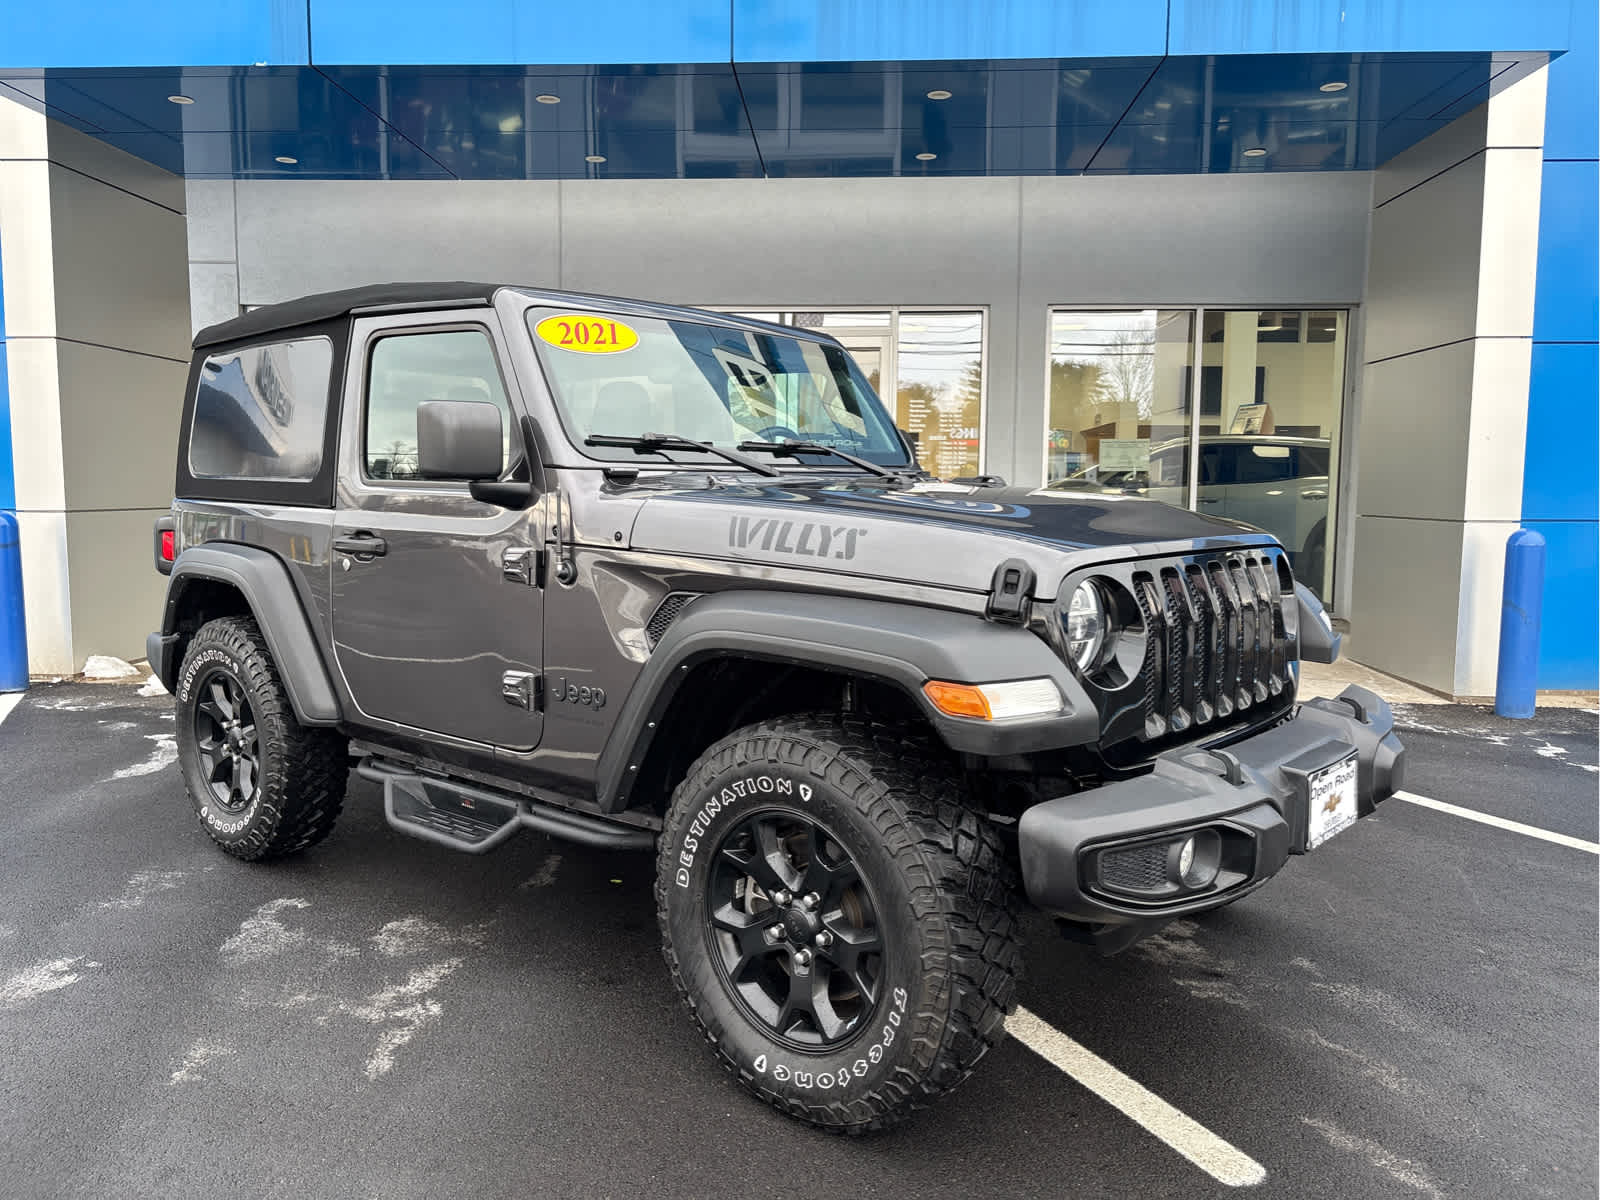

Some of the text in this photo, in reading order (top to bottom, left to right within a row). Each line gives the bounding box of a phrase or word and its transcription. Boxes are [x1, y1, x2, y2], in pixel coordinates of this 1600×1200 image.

[557, 322, 620, 345] 2021
[728, 516, 868, 561] WILLYS
[552, 677, 607, 712] Jeep
[1311, 769, 1355, 801] Open Road
[676, 775, 793, 889] DESTINATION
[774, 987, 909, 1089] Firestone
